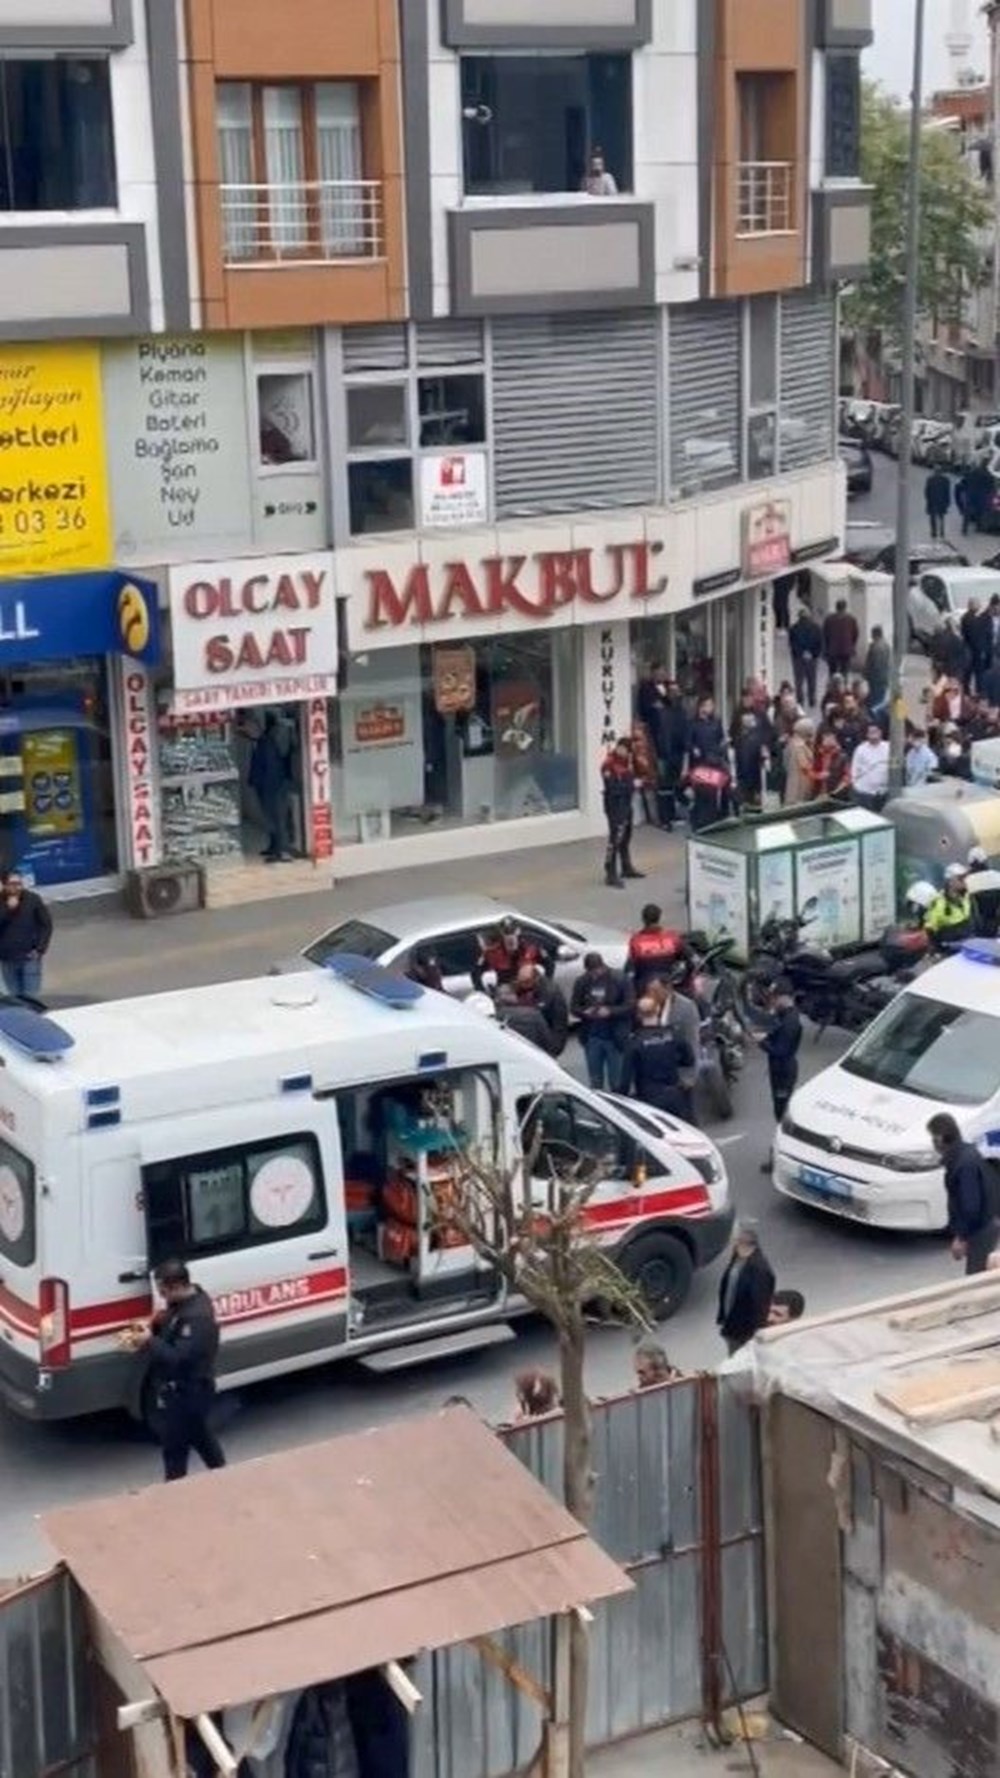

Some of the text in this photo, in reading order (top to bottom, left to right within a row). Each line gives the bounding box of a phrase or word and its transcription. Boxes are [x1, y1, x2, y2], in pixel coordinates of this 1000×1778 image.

[140, 366, 206, 384] Keman
[149, 389, 200, 409] Gitar
[135, 438, 219, 463] Bağlama
[161, 486, 200, 505] Ney
[56, 506, 87, 530] 36
[168, 509, 195, 527] Ud
[184, 570, 326, 620] OLCAY
[364, 540, 667, 629] MAKBUL
[205, 626, 313, 674] SAAT
[127, 672, 149, 777] OLCAY
[212, 1278, 310, 1315] MBULANS
